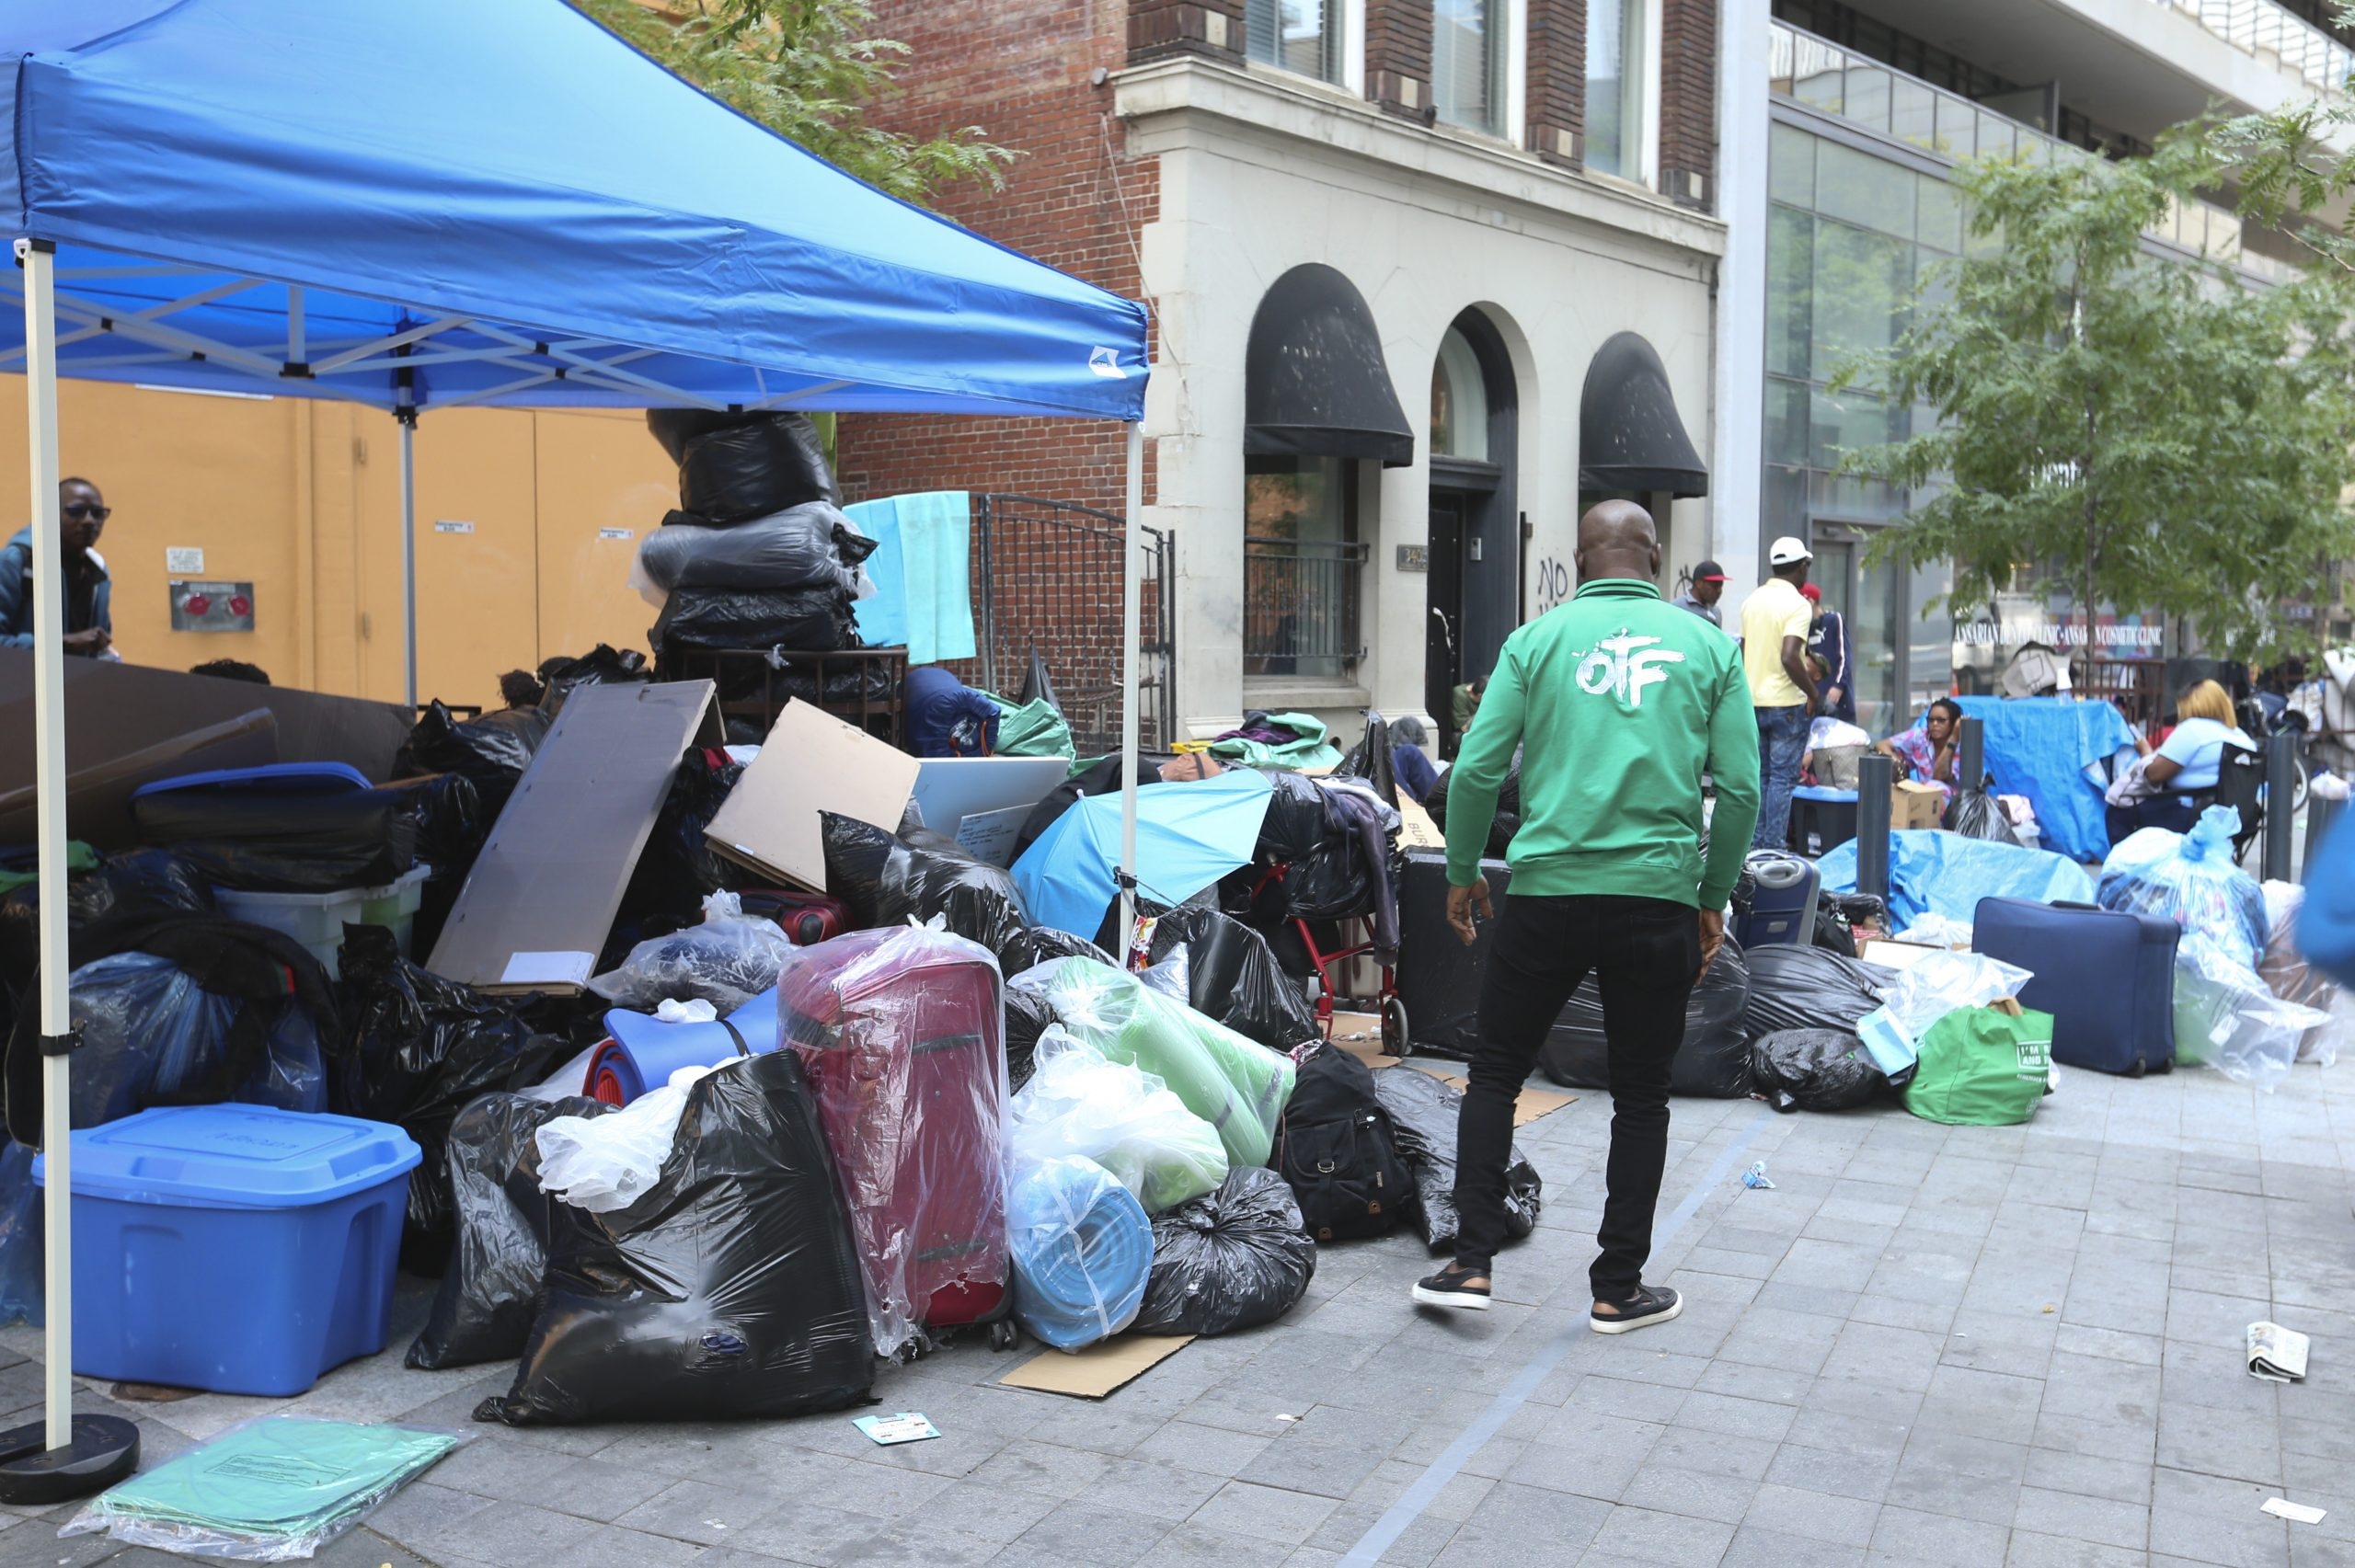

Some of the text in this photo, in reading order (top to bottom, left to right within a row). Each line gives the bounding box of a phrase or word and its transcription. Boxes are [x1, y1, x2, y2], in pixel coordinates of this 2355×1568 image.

[1538, 556, 1568, 601] NO
[1575, 633, 1685, 707] OTF
[1407, 822, 1429, 846] BUR
